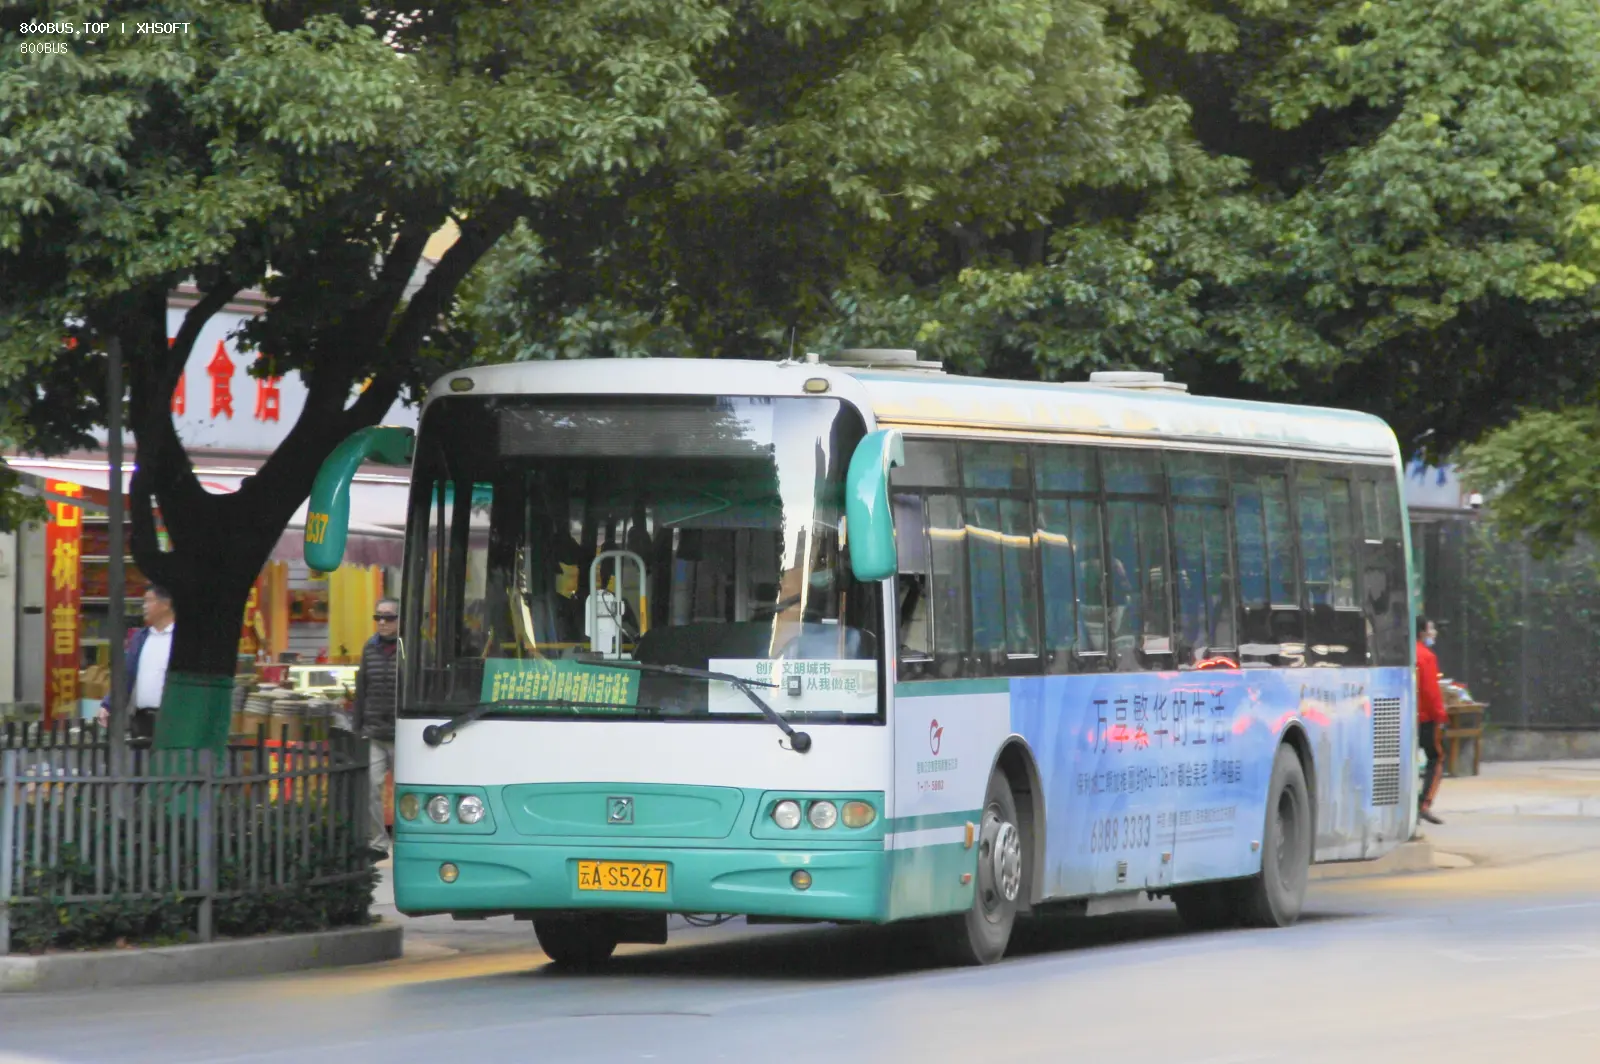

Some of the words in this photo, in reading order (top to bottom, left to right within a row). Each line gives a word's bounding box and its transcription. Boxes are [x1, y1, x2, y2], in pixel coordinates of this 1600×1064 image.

[169, 338, 281, 422] 食店
[807, 677, 858, 691] 从我做起
[1122, 814, 1151, 849] 3333
